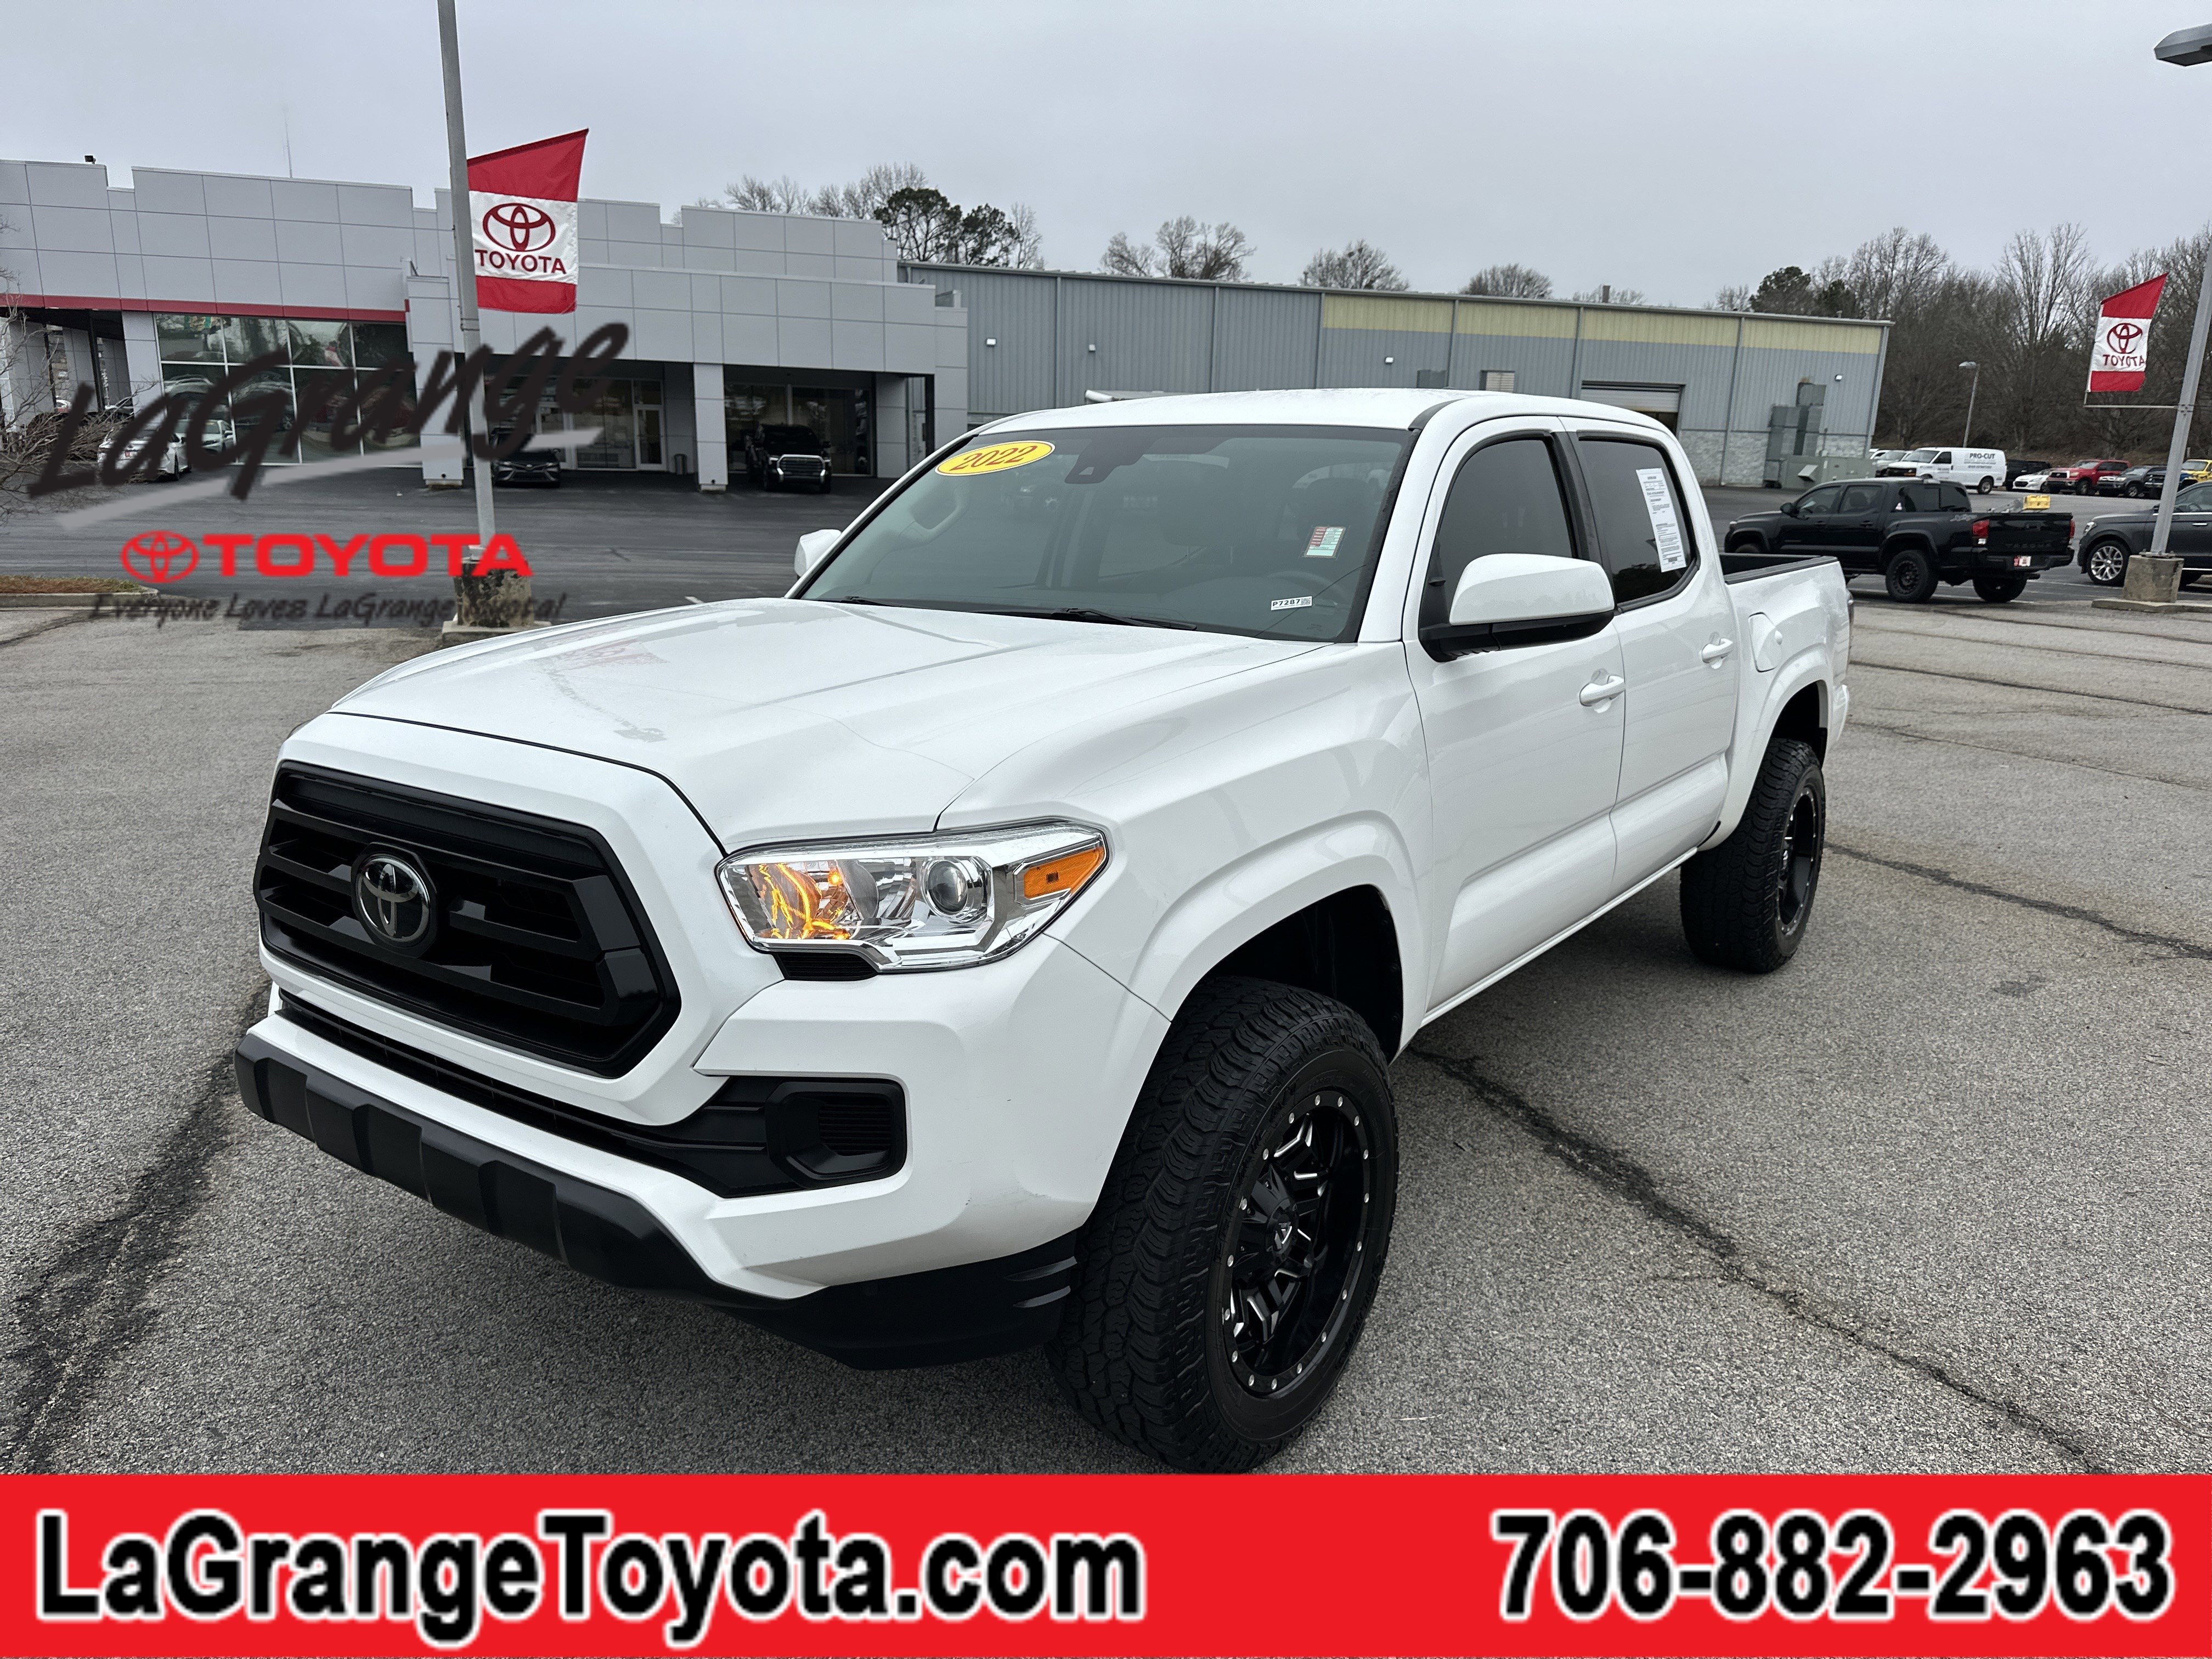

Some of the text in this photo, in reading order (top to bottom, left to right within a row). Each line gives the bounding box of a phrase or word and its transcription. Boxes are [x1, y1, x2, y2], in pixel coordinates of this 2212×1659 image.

[475, 249, 567, 275] TOYOTA
[2102, 354, 2145, 366] TOYOTA
[949, 445, 1038, 471] 2022
